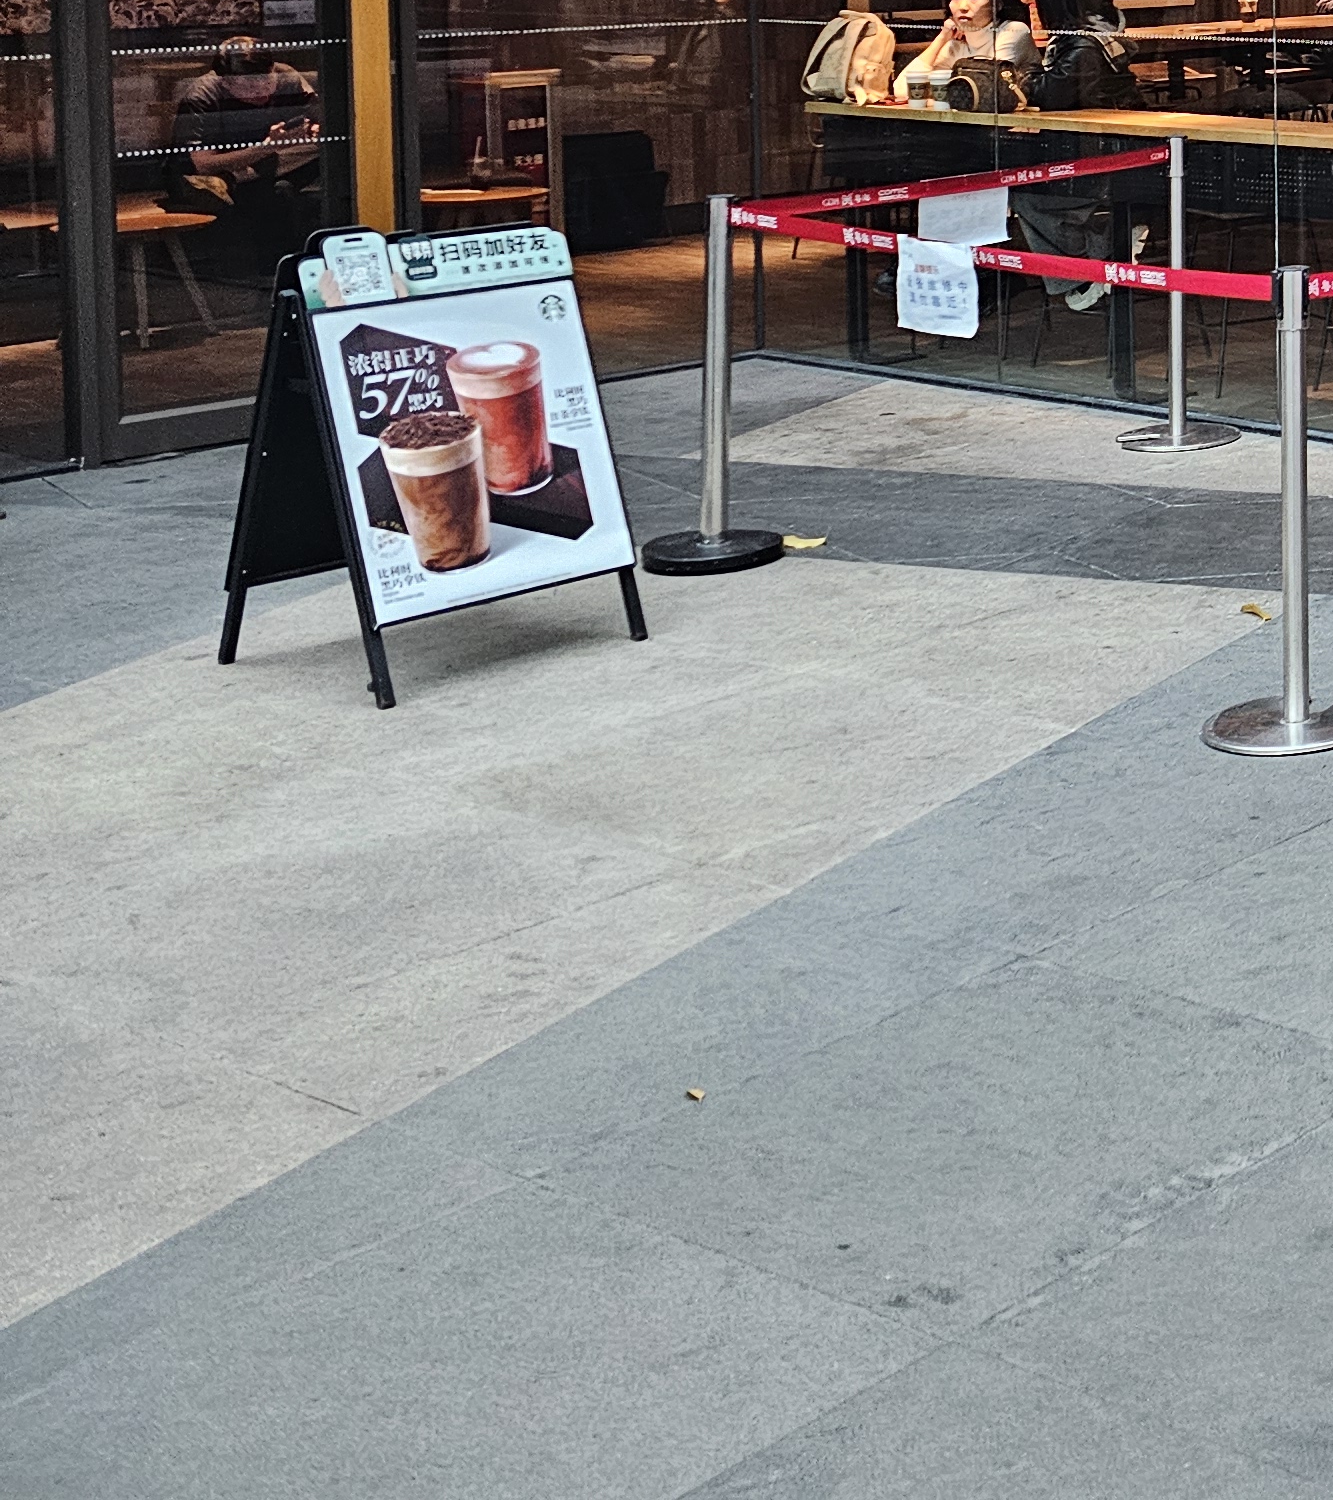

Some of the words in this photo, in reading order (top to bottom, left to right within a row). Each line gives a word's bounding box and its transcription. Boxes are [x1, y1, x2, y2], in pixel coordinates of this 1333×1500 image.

[439, 232, 549, 263] 扫码加好友
[347, 344, 436, 376] 浓得正巧
[359, 367, 440, 419] 57%
[407, 390, 444, 413] 黑巧
